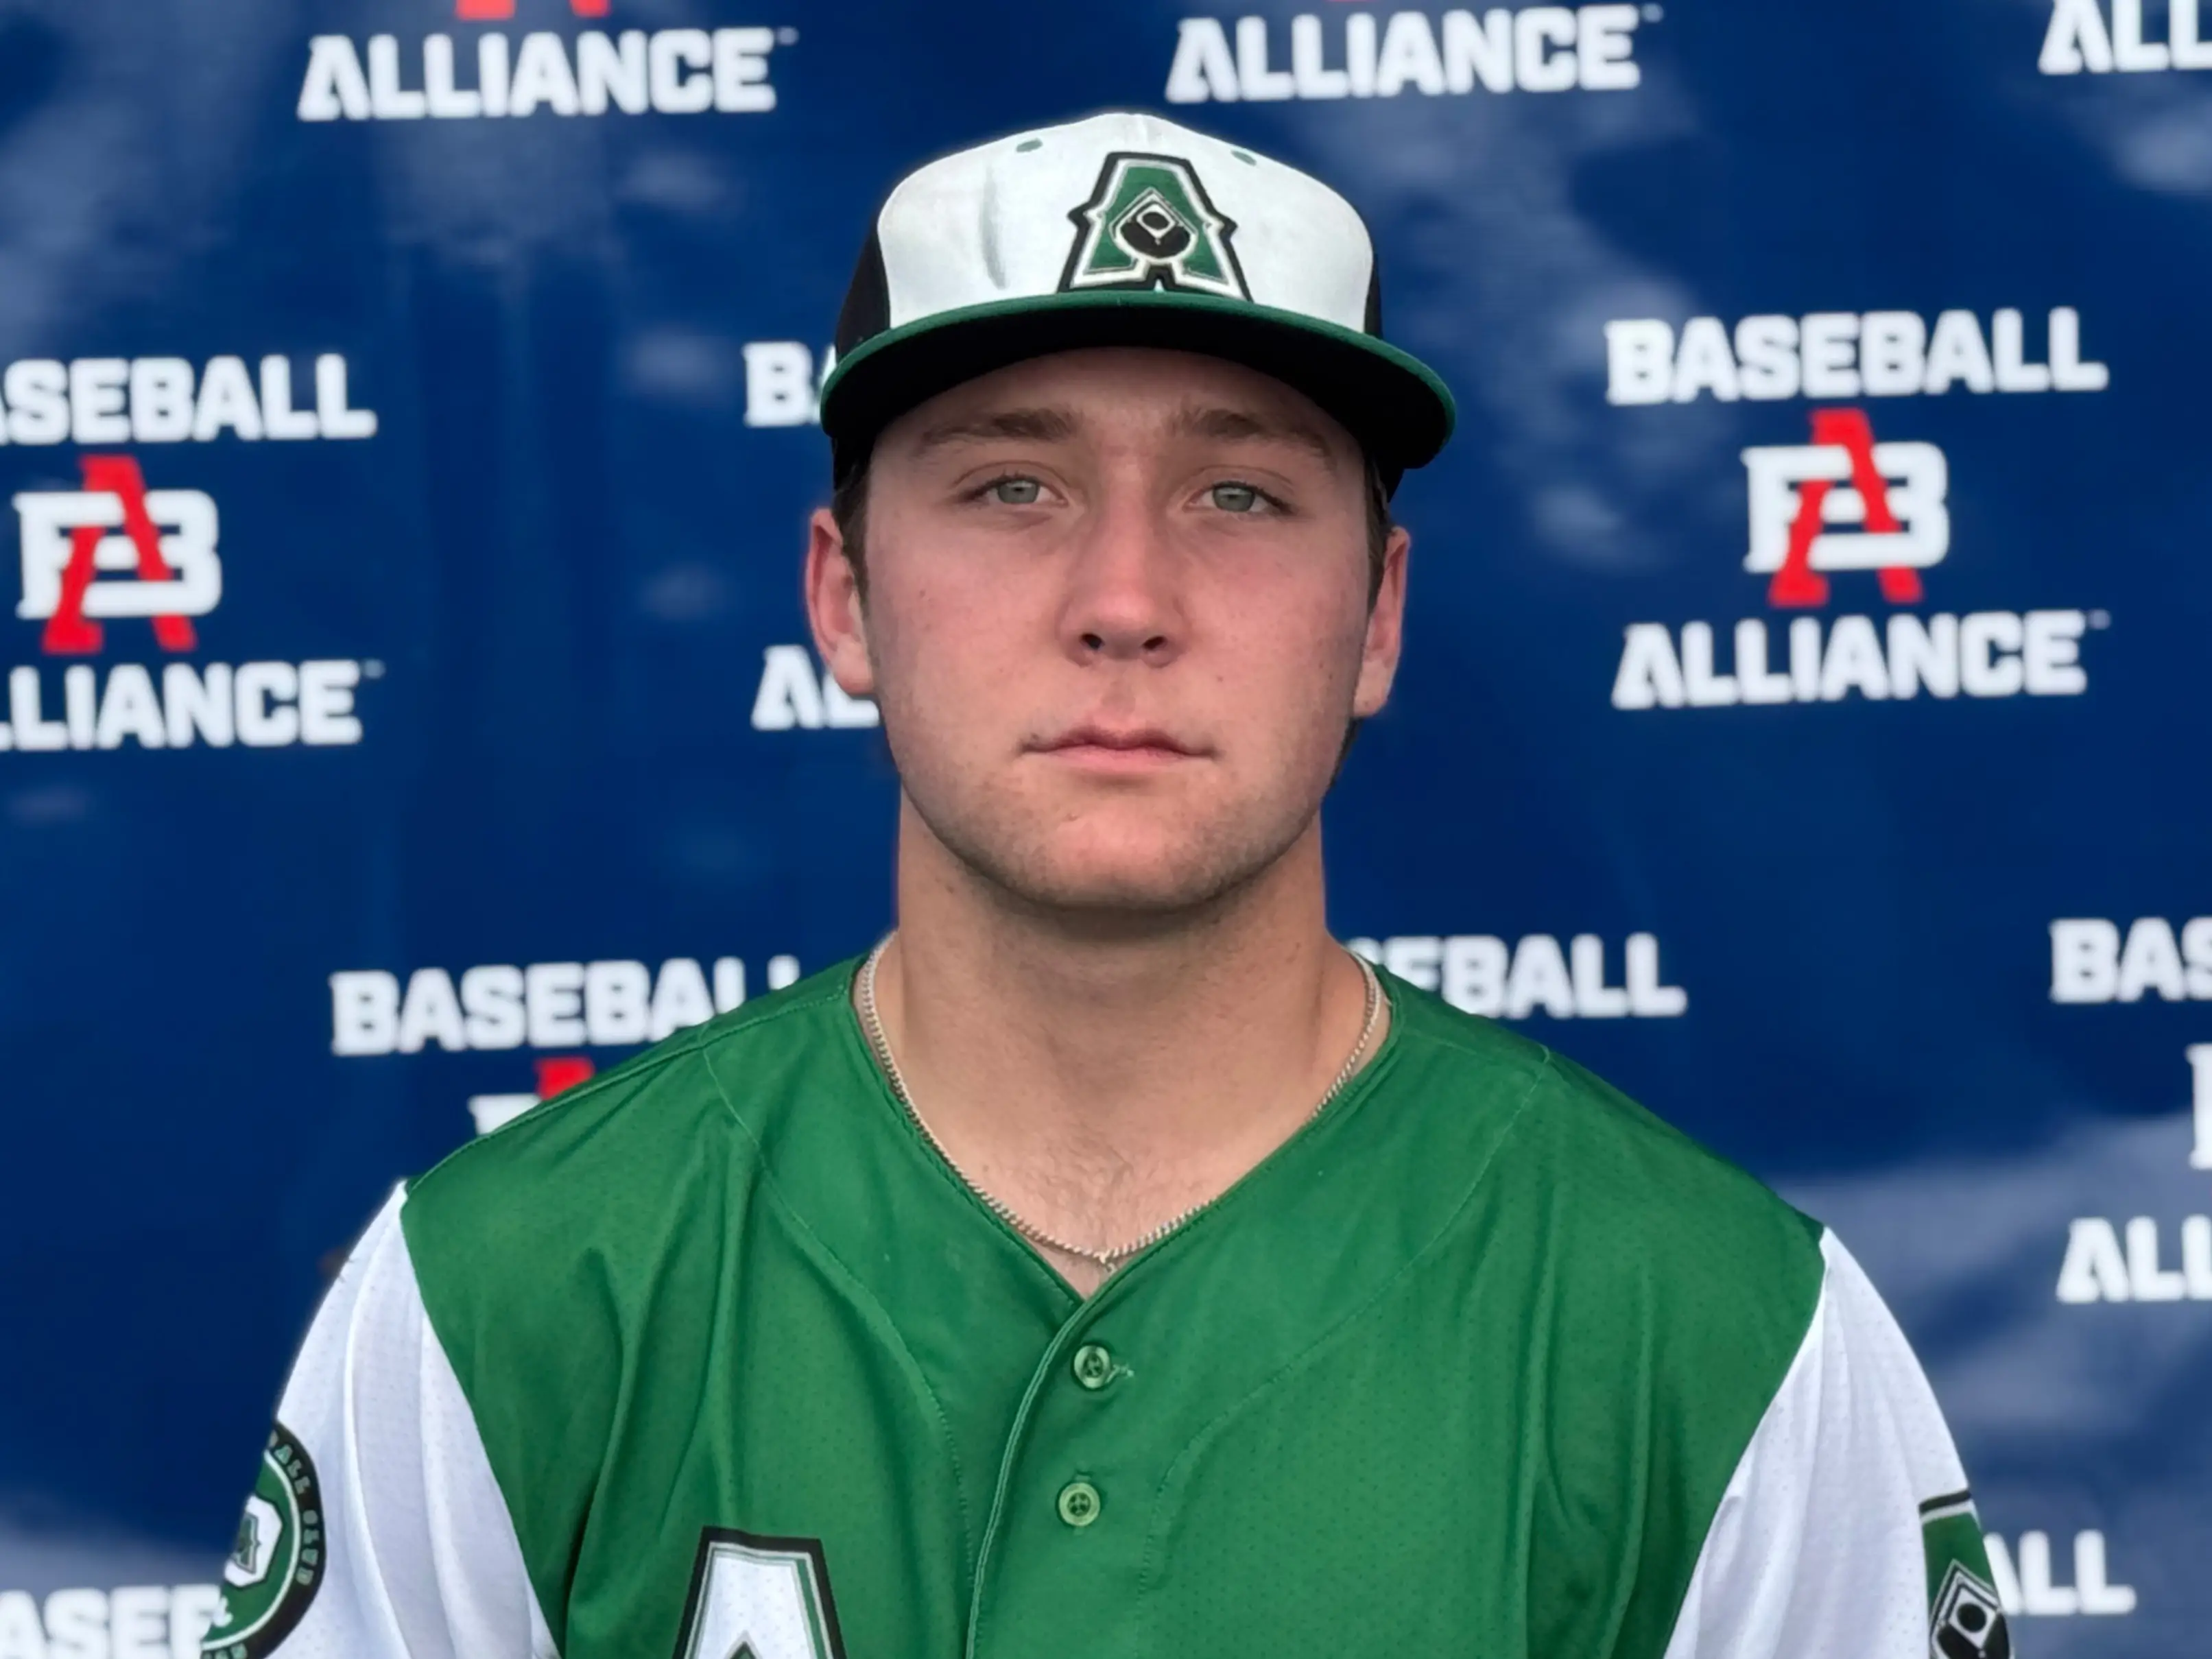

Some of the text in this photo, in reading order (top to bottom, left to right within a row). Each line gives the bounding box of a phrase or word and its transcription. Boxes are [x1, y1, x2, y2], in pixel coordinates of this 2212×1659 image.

[297, 27, 776, 121] ALLIANCE
[1165, 4, 1641, 102] ALLIANCE
[0, 353, 377, 444] SEBALL
[1604, 307, 2109, 405] BASEBALL
[0, 660, 363, 750] LIANCE
[1611, 610, 2087, 710] ALLIANCE
